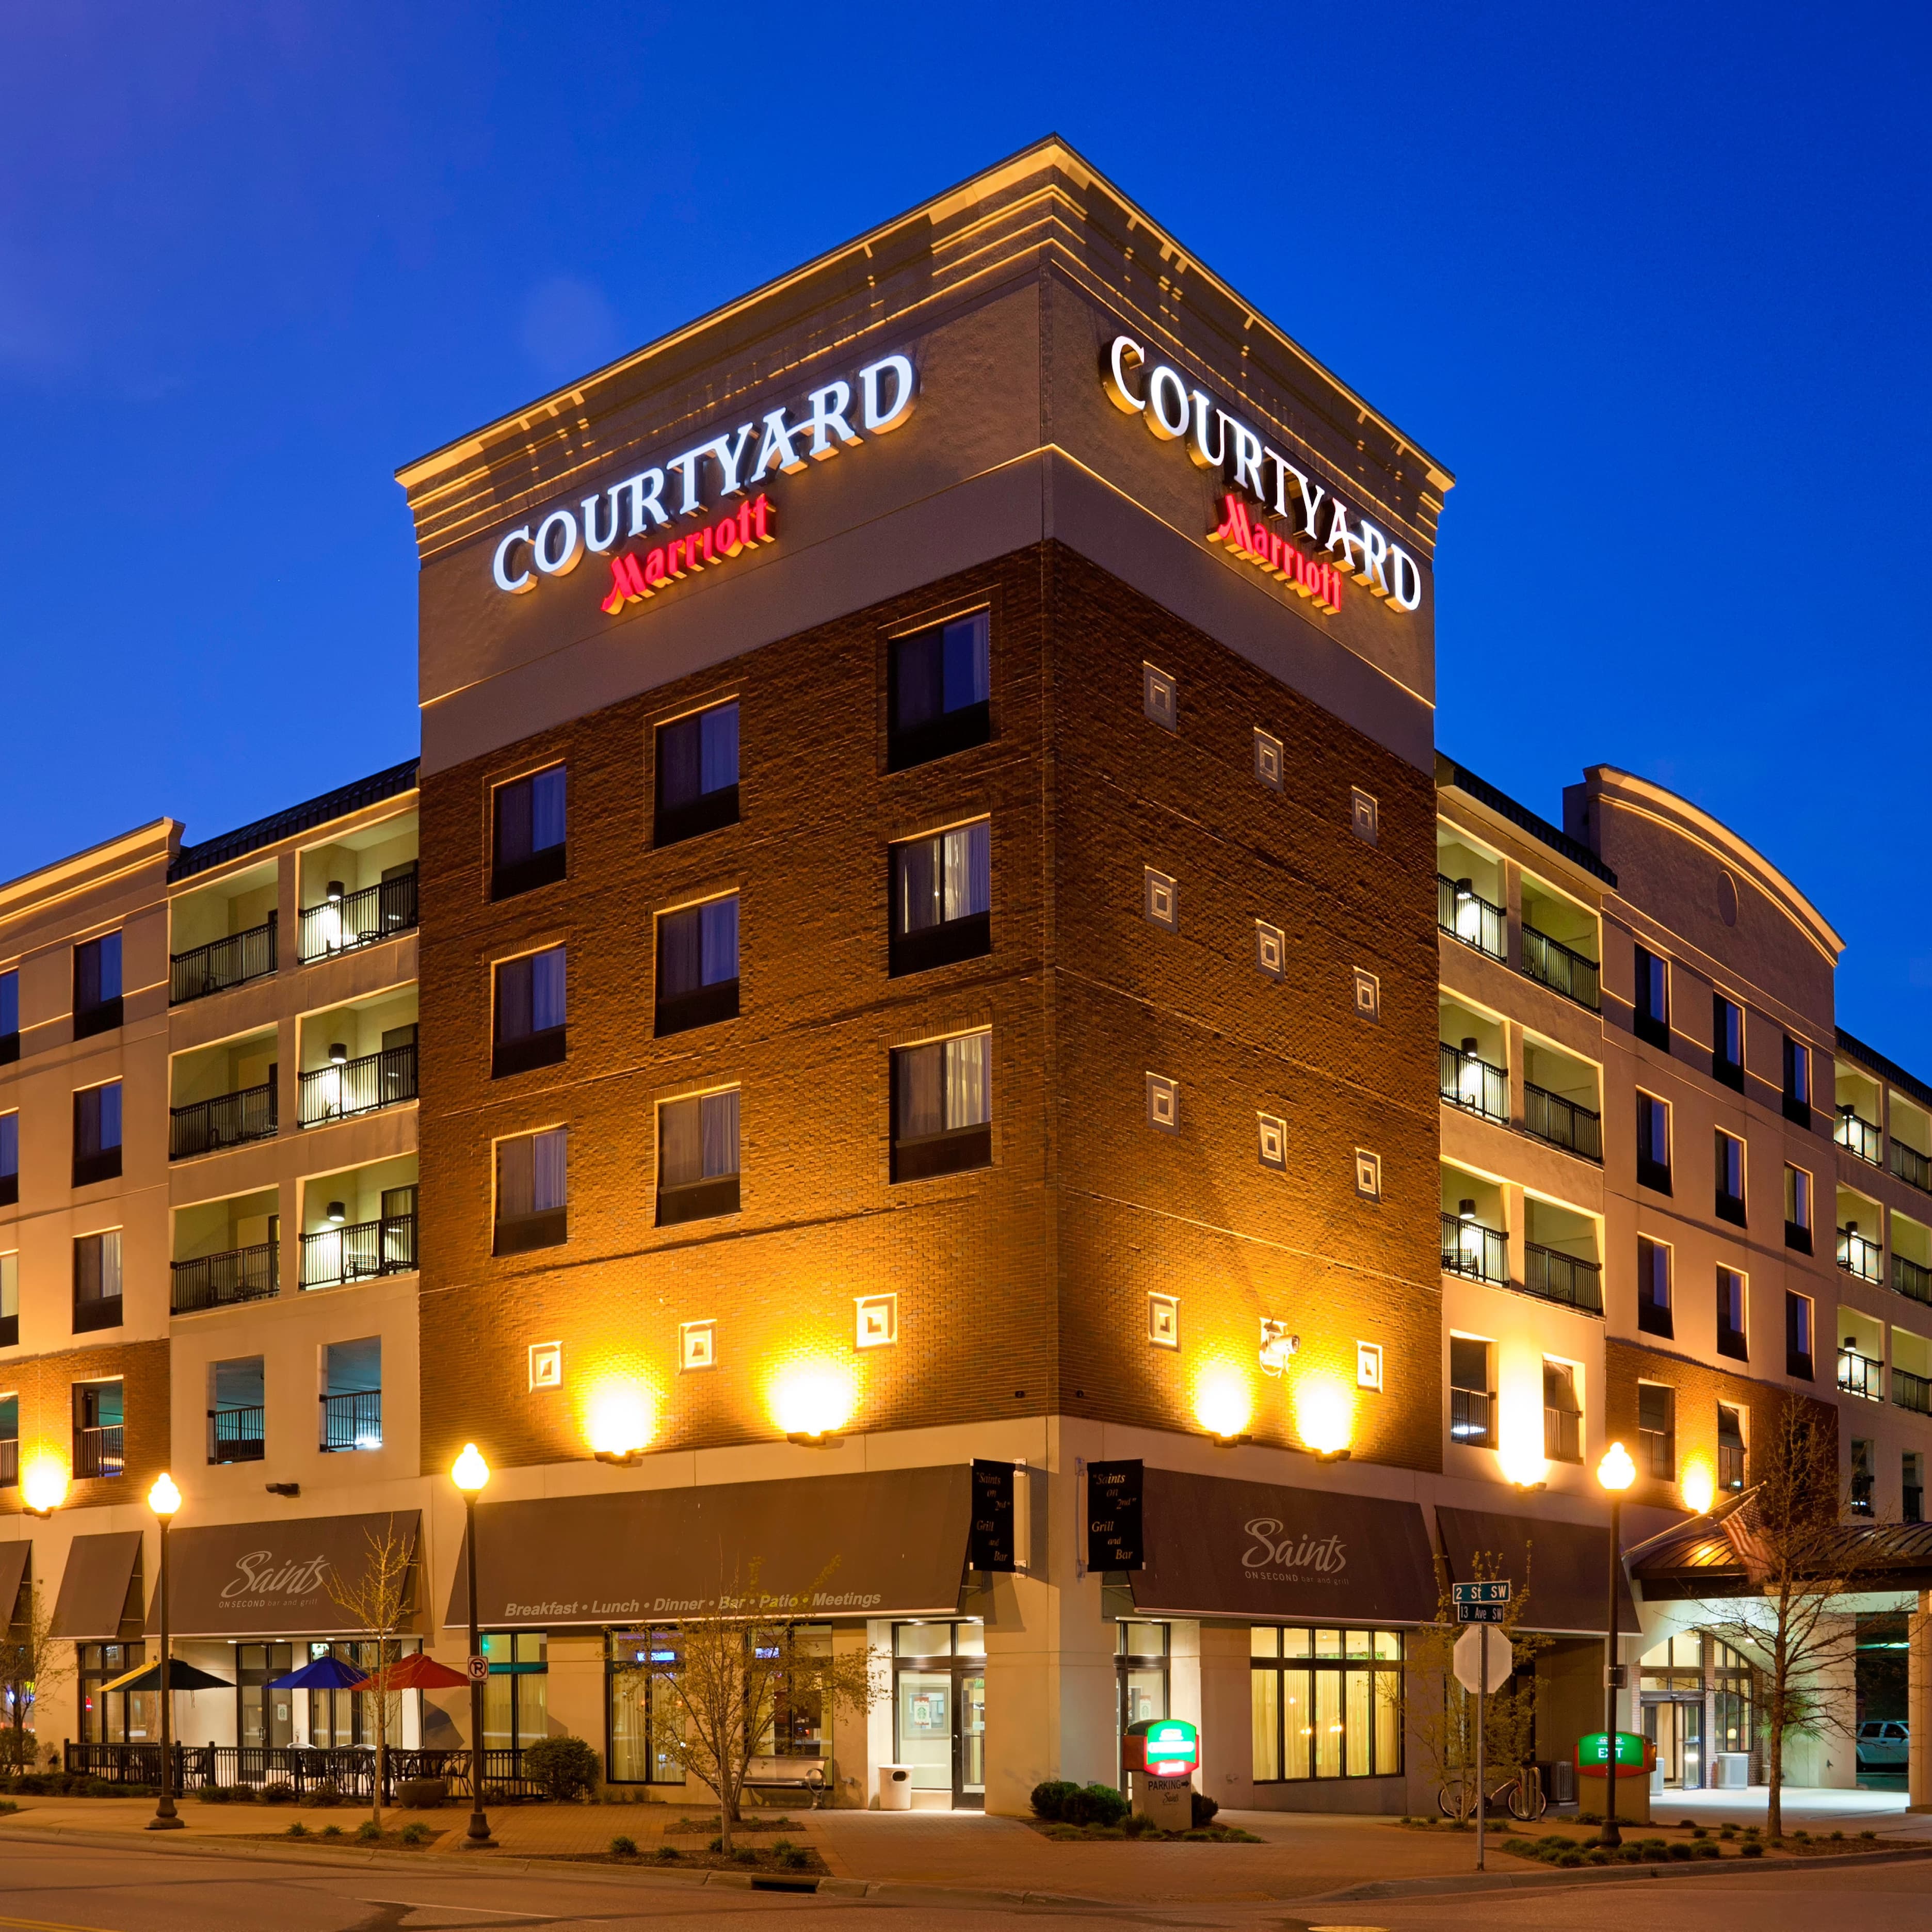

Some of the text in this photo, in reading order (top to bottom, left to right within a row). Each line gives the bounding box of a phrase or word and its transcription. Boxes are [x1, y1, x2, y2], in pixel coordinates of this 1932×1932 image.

[493, 355, 913, 592] COURTYARD
[1112, 336, 1421, 610] COURTYARD
[601, 493, 772, 613] Marriott
[1217, 494, 1342, 612] Marriott
[987, 1489, 996, 1498] on
[1106, 1488, 1118, 1497] on
[976, 1520, 994, 1532] Grill
[1092, 1521, 1114, 1532] Grill
[1107, 1537, 1121, 1545] and
[1242, 1518, 1347, 1574] Saints
[994, 1550, 1008, 1561] Bar
[1116, 1549, 1133, 1559] Bar
[220, 1550, 331, 1598] Saints
[1456, 1585, 1507, 1600] 2 St SW
[300, 1599, 318, 1607] grill
[505, 1592, 881, 1617] Breakfast Lunch Dinner Bar Patio Meetings
[1461, 1605, 1502, 1620] 13 Ave SW
[1598, 1748, 1623, 1758] ET
[1148, 1780, 1181, 1791] PARKING
